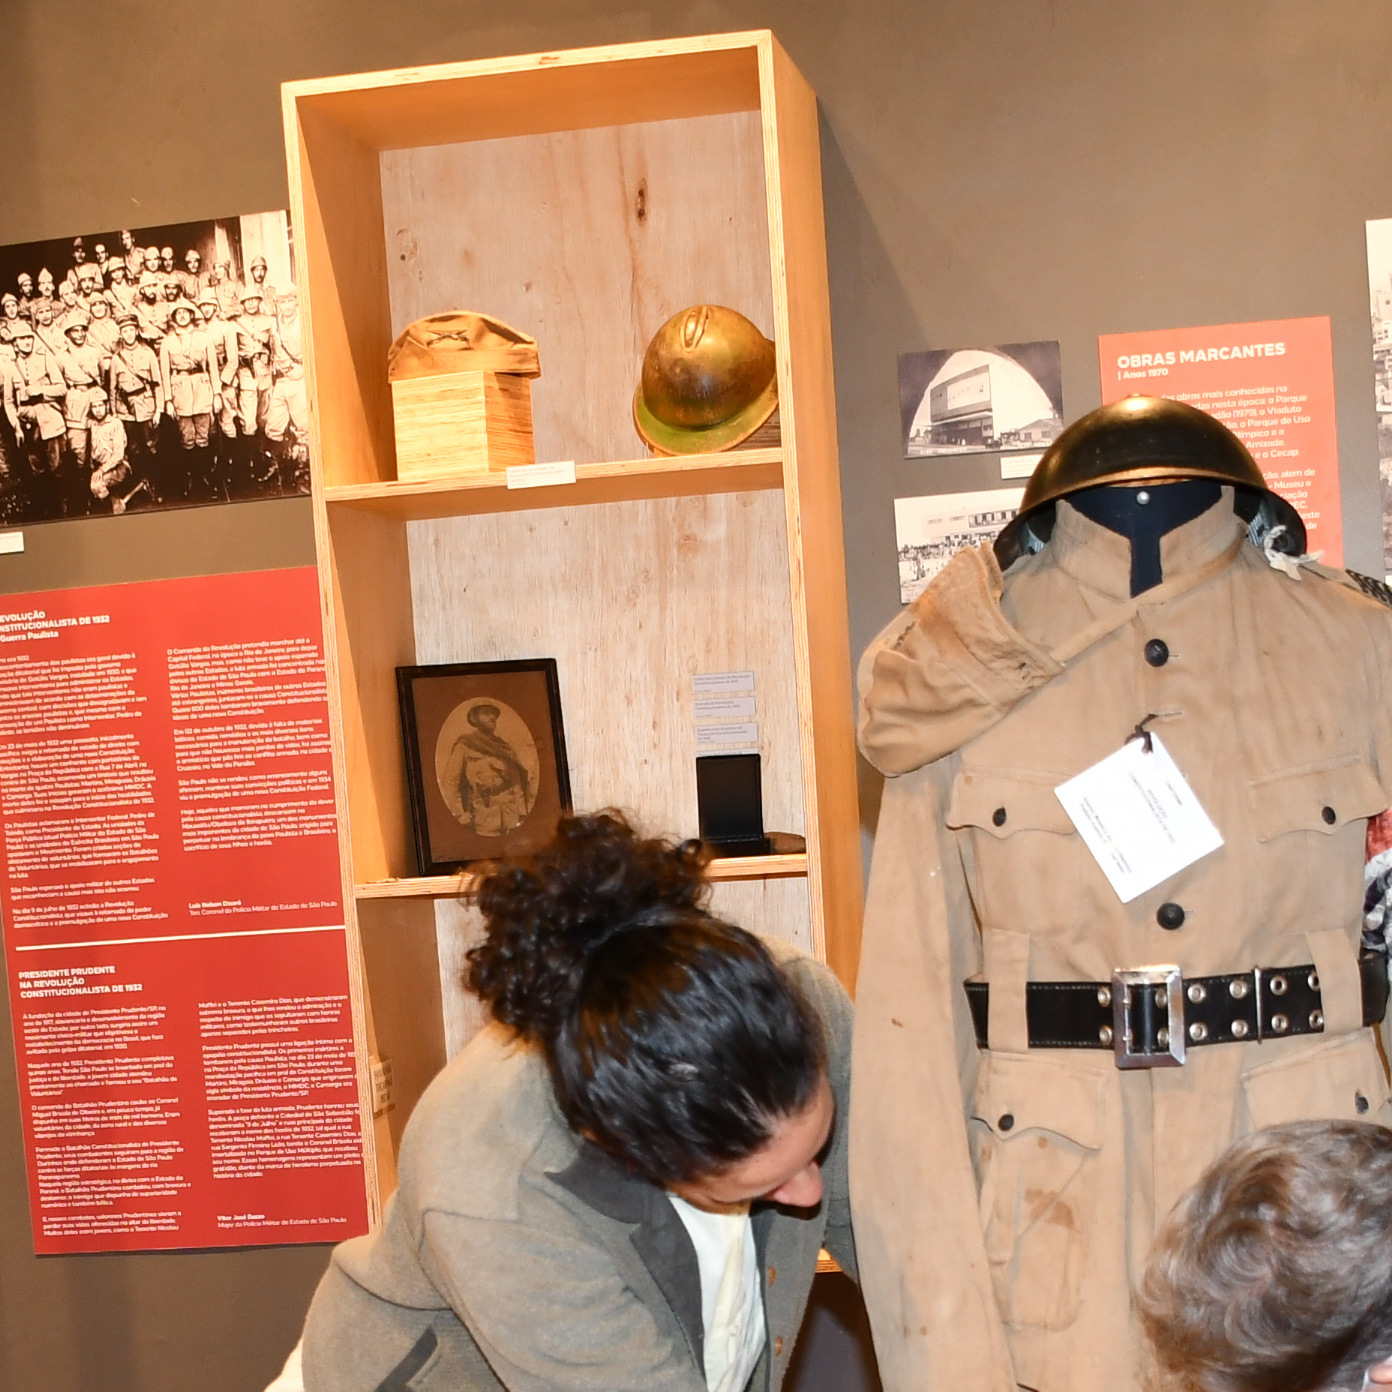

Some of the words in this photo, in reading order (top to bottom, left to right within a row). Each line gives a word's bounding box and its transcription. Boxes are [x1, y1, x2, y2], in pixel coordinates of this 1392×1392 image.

[1117, 351, 1176, 369] OBRAS
[1179, 342, 1286, 364] MARCANTES
[1122, 371, 1147, 379] Anos
[1147, 367, 1169, 377] 1970
[1176, 392, 1201, 401] obras
[1201, 391, 1224, 399] mais
[1224, 386, 1275, 397] conhecidas
[1275, 385, 1288, 393] na
[1211, 400, 1237, 409] nesta
[1275, 395, 1307, 404] Parque
[1267, 405, 1302, 415] Viaduto
[1247, 418, 1279, 428] Parque
[1280, 416, 1292, 425] de
[1293, 415, 1311, 424] Uso
[1273, 480, 1305, 490] Museu
[79, 616, 92, 625] DE
[92, 615, 110, 624] 1932
[0, 634, 27, 643] Guerra
[27, 630, 59, 640] Paulista
[18, 968, 70, 980] PRESIDENTE
[70, 965, 116, 978] PRUDENTE
[19, 978, 33, 989] NA
[33, 976, 85, 988] REVOLUÇÃO
[20, 985, 111, 999] CONSTITUCIONALISTA
[111, 984, 124, 993] DE
[124, 983, 143, 992] 1932
